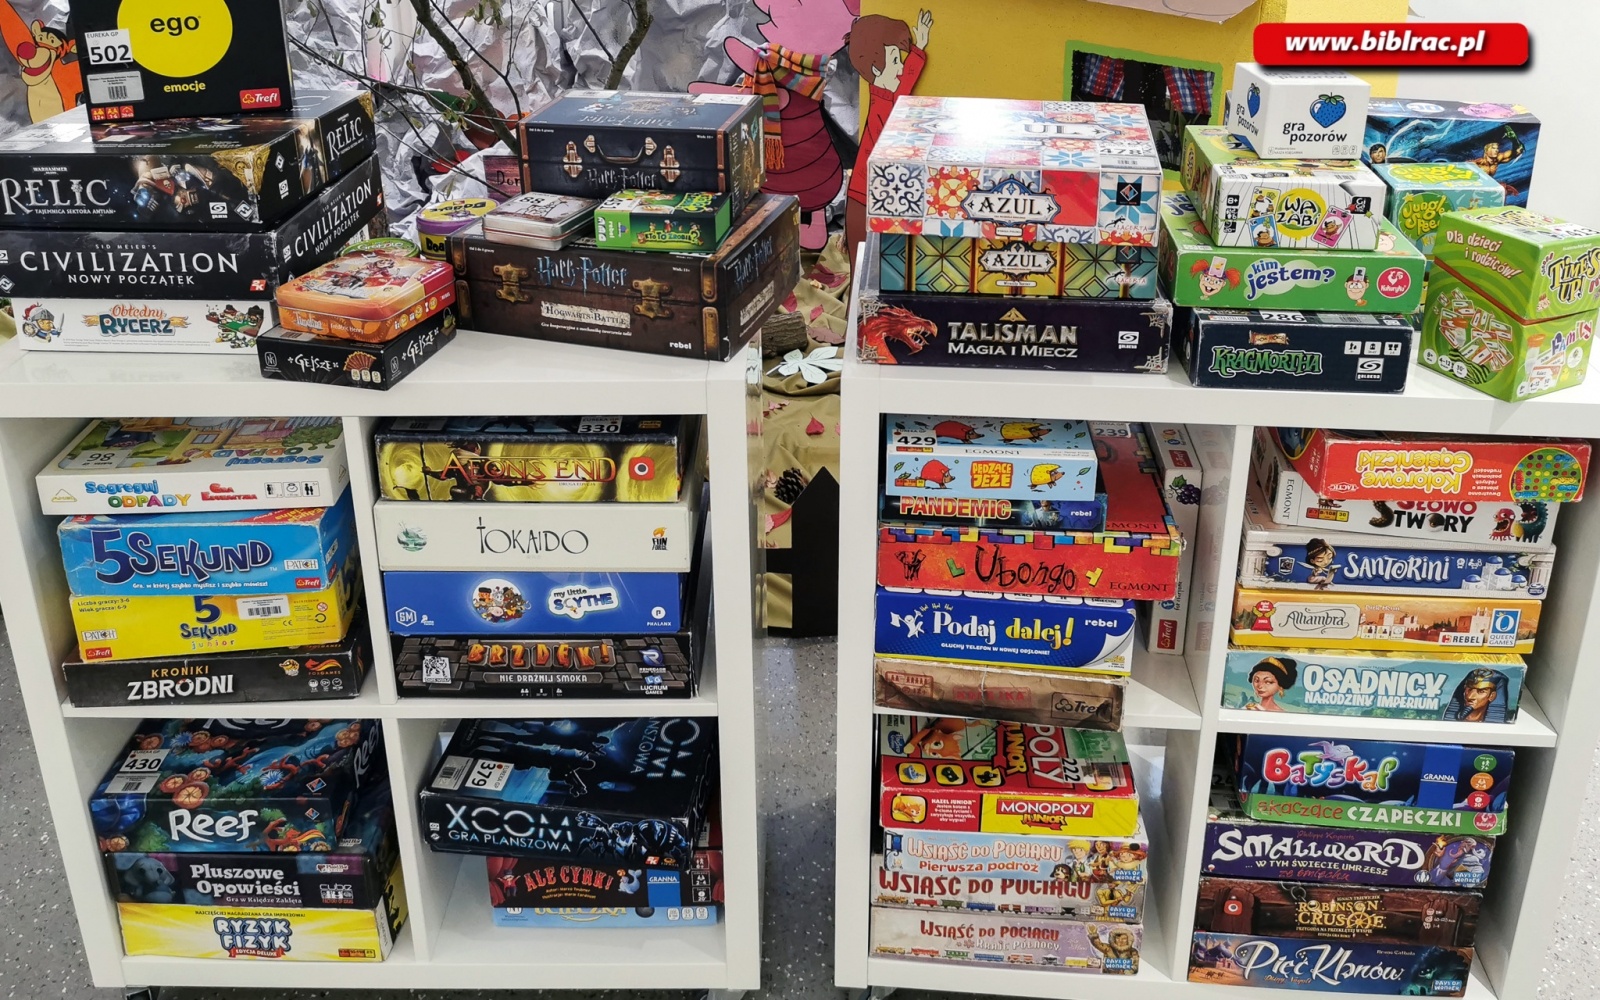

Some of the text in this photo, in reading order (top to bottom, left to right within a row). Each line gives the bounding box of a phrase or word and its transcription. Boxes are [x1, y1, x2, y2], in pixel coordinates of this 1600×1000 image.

[150, 15, 200, 36] ego
[90, 44, 132, 63] 502
[163, 81, 206, 93] emocje
[254, 92, 278, 104] Trefl
[1236, 103, 1245, 116] gra
[1237, 116, 1260, 136] pozorów
[1282, 122, 1305, 135] gra
[326, 117, 363, 161] RELIC
[1289, 130, 1348, 145] pozorów
[0, 178, 111, 215] RELIC
[1285, 197, 1317, 213] WA
[978, 197, 1041, 214] AZUL
[1402, 195, 1447, 220] Jungle
[294, 178, 372, 257] CIVILIZATION
[315, 210, 360, 254] NOWY POCZĄTEK
[1117, 224, 1148, 232] LACERTA
[1446, 230, 1464, 243] Dla
[1468, 233, 1503, 251] dzieci
[20, 251, 239, 273] CIVILIZATION
[992, 254, 1042, 268] AZUL
[1251, 259, 1279, 274] kim
[1465, 247, 1523, 280] i rodziców!
[68, 275, 195, 286] NOWY POCZĄTEK
[536, 256, 629, 297] Harry Potter
[1247, 267, 1336, 300] jestem?
[251, 280, 265, 291] 2K
[1559, 275, 1585, 304] UP!
[545, 305, 627, 325] HOGWARTS BATTLE
[1261, 312, 1306, 322] 286
[99, 313, 175, 336] RYCERZ
[947, 321, 1079, 345] TALISMAN
[669, 341, 692, 350] rebel
[947, 343, 1007, 355] MAGIA
[1021, 346, 1078, 358] MIECZ
[1209, 346, 1323, 378] KRAGMORTHA
[580, 425, 619, 433] 330
[1095, 428, 1129, 437] 239
[897, 436, 936, 446] 429
[225, 455, 324, 467] Segreguj
[1357, 447, 1473, 473] Gąsieniczki
[85, 479, 159, 495] Segreguj
[973, 473, 1012, 488] JEŻE
[1330, 484, 1357, 492] TACTIC
[1361, 472, 1462, 494] Kolorowe
[108, 494, 192, 508] ODPADY
[900, 495, 1012, 520] PANDEMIC
[1283, 478, 1295, 520] EGMONT
[1396, 500, 1477, 515] SŁOWO
[476, 516, 589, 554] TOKAIDO
[652, 538, 668, 546] FUN
[91, 528, 273, 584] 5 SEKUND
[285, 560, 318, 569] PATCH
[975, 543, 1076, 593] Ubongo
[1343, 553, 1450, 582] SANTORINI
[304, 578, 321, 586] Trefl
[1110, 581, 1170, 592] EGMONT
[567, 588, 588, 596] little
[193, 596, 221, 623] 5
[553, 593, 613, 611] SCYTHE
[1085, 619, 1117, 628] rebel
[1279, 607, 1350, 634] Alhambra
[84, 630, 116, 640] PATCH
[180, 622, 237, 640] SEKUND
[933, 611, 1074, 650] Podaj dalej!
[1162, 621, 1172, 638] Trefl
[191, 639, 235, 650] junior
[1452, 635, 1480, 644] REBEL
[95, 649, 111, 657] Trefl
[467, 643, 610, 668] BRZDĘK!
[151, 665, 210, 678] KRONIKI
[516, 673, 553, 683] DRAŻNIJ
[556, 674, 588, 683] SMOKA
[126, 675, 234, 700] ZBRODNI
[1303, 665, 1446, 698] OSADNICY
[1075, 700, 1108, 716] Trefl
[1304, 691, 1439, 710] NARODZINY IMPERIUM
[124, 757, 162, 770] 430
[1062, 757, 1082, 783] 222
[471, 761, 496, 788] 379
[498, 765, 508, 782] EUREKA
[1423, 773, 1455, 781] GRANNA
[1000, 801, 1091, 816] MONOPOLY
[1257, 800, 1461, 828] skaczące CZAPECZKI
[168, 808, 258, 842] Reef
[445, 803, 573, 842] XCOM
[1022, 814, 1067, 826] JUNIOR
[448, 829, 572, 853] GRA PLANSZOWA
[908, 837, 1062, 861] WSIĄŚĆ DO POCIĄGU
[1211, 829, 1425, 871] SMALLWORLD
[190, 864, 284, 880] Pluszowe
[919, 860, 1039, 873] Pierwsza podróż
[1255, 859, 1388, 876] W TYM ŚWIECIE UMRZESZ
[1278, 868, 1351, 881] ze śmiechu
[524, 865, 614, 891] ALE CYRK!
[196, 880, 300, 897] Opowieści
[247, 896, 274, 904] Księdze
[274, 897, 302, 905] Zaklęta
[1298, 899, 1378, 913] ROBINSON
[213, 917, 292, 936] RYZYK
[1297, 911, 1384, 929] CRUSOE
[920, 920, 1060, 943] WSIĄŚĆ DO POCIĄGU
[220, 934, 291, 951] FIZYK
[1012, 939, 1060, 952] PÓŁNOCY
[1235, 942, 1405, 986] Pięć Klanów
